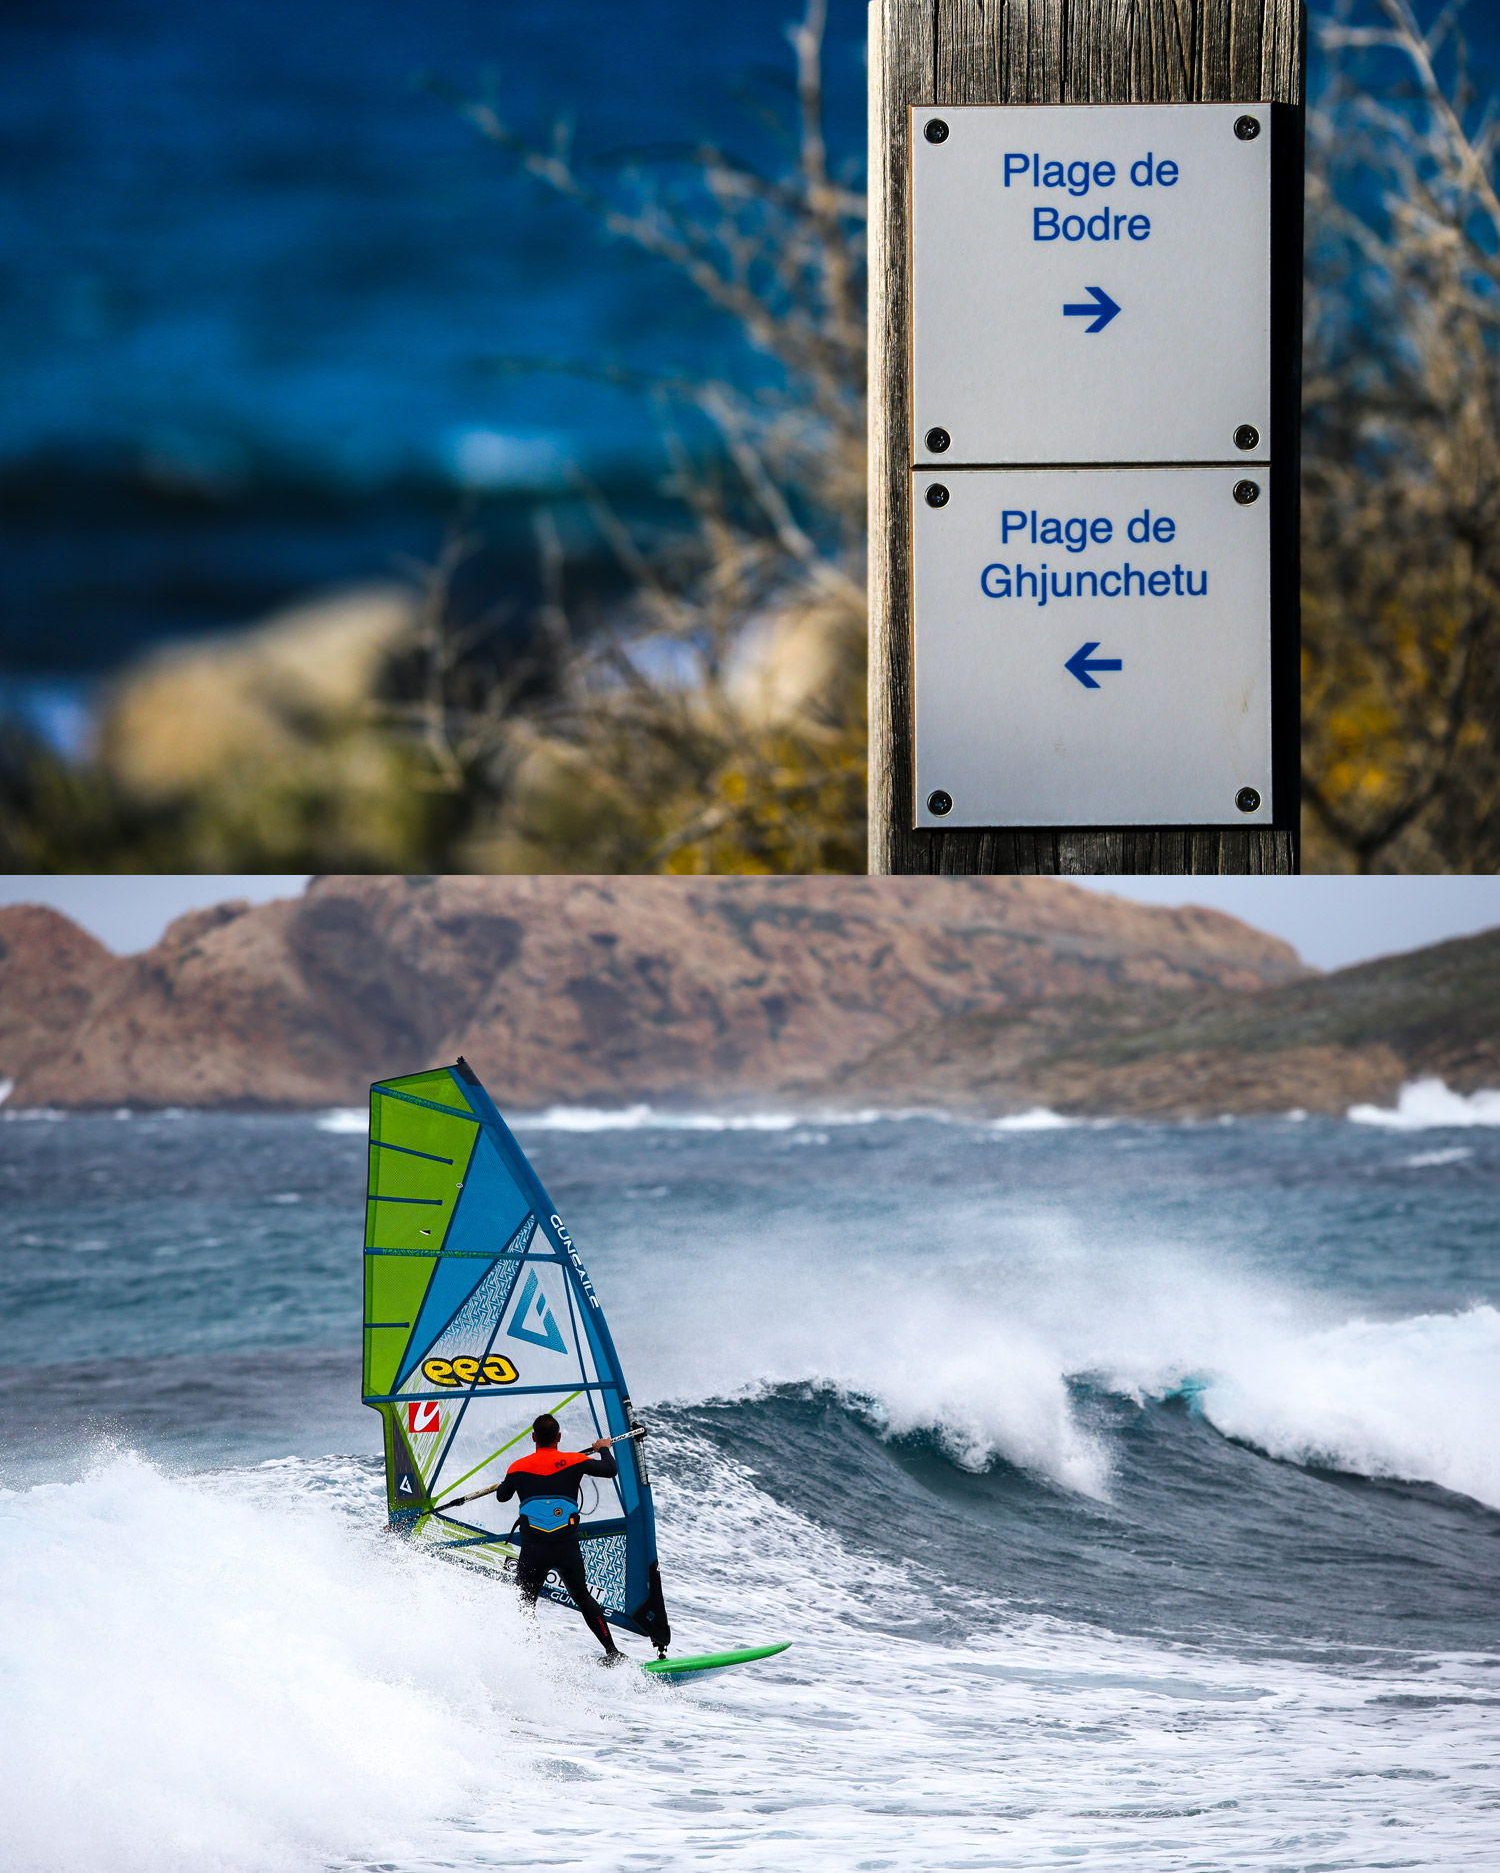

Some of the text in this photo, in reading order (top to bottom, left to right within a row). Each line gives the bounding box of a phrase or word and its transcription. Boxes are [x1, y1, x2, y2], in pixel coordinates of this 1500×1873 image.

[1003, 152, 1179, 197] Plage de
[1033, 206, 1151, 241] Bodre
[1001, 509, 1176, 553] Plage de
[980, 563, 1208, 607] Ghjunchetu
